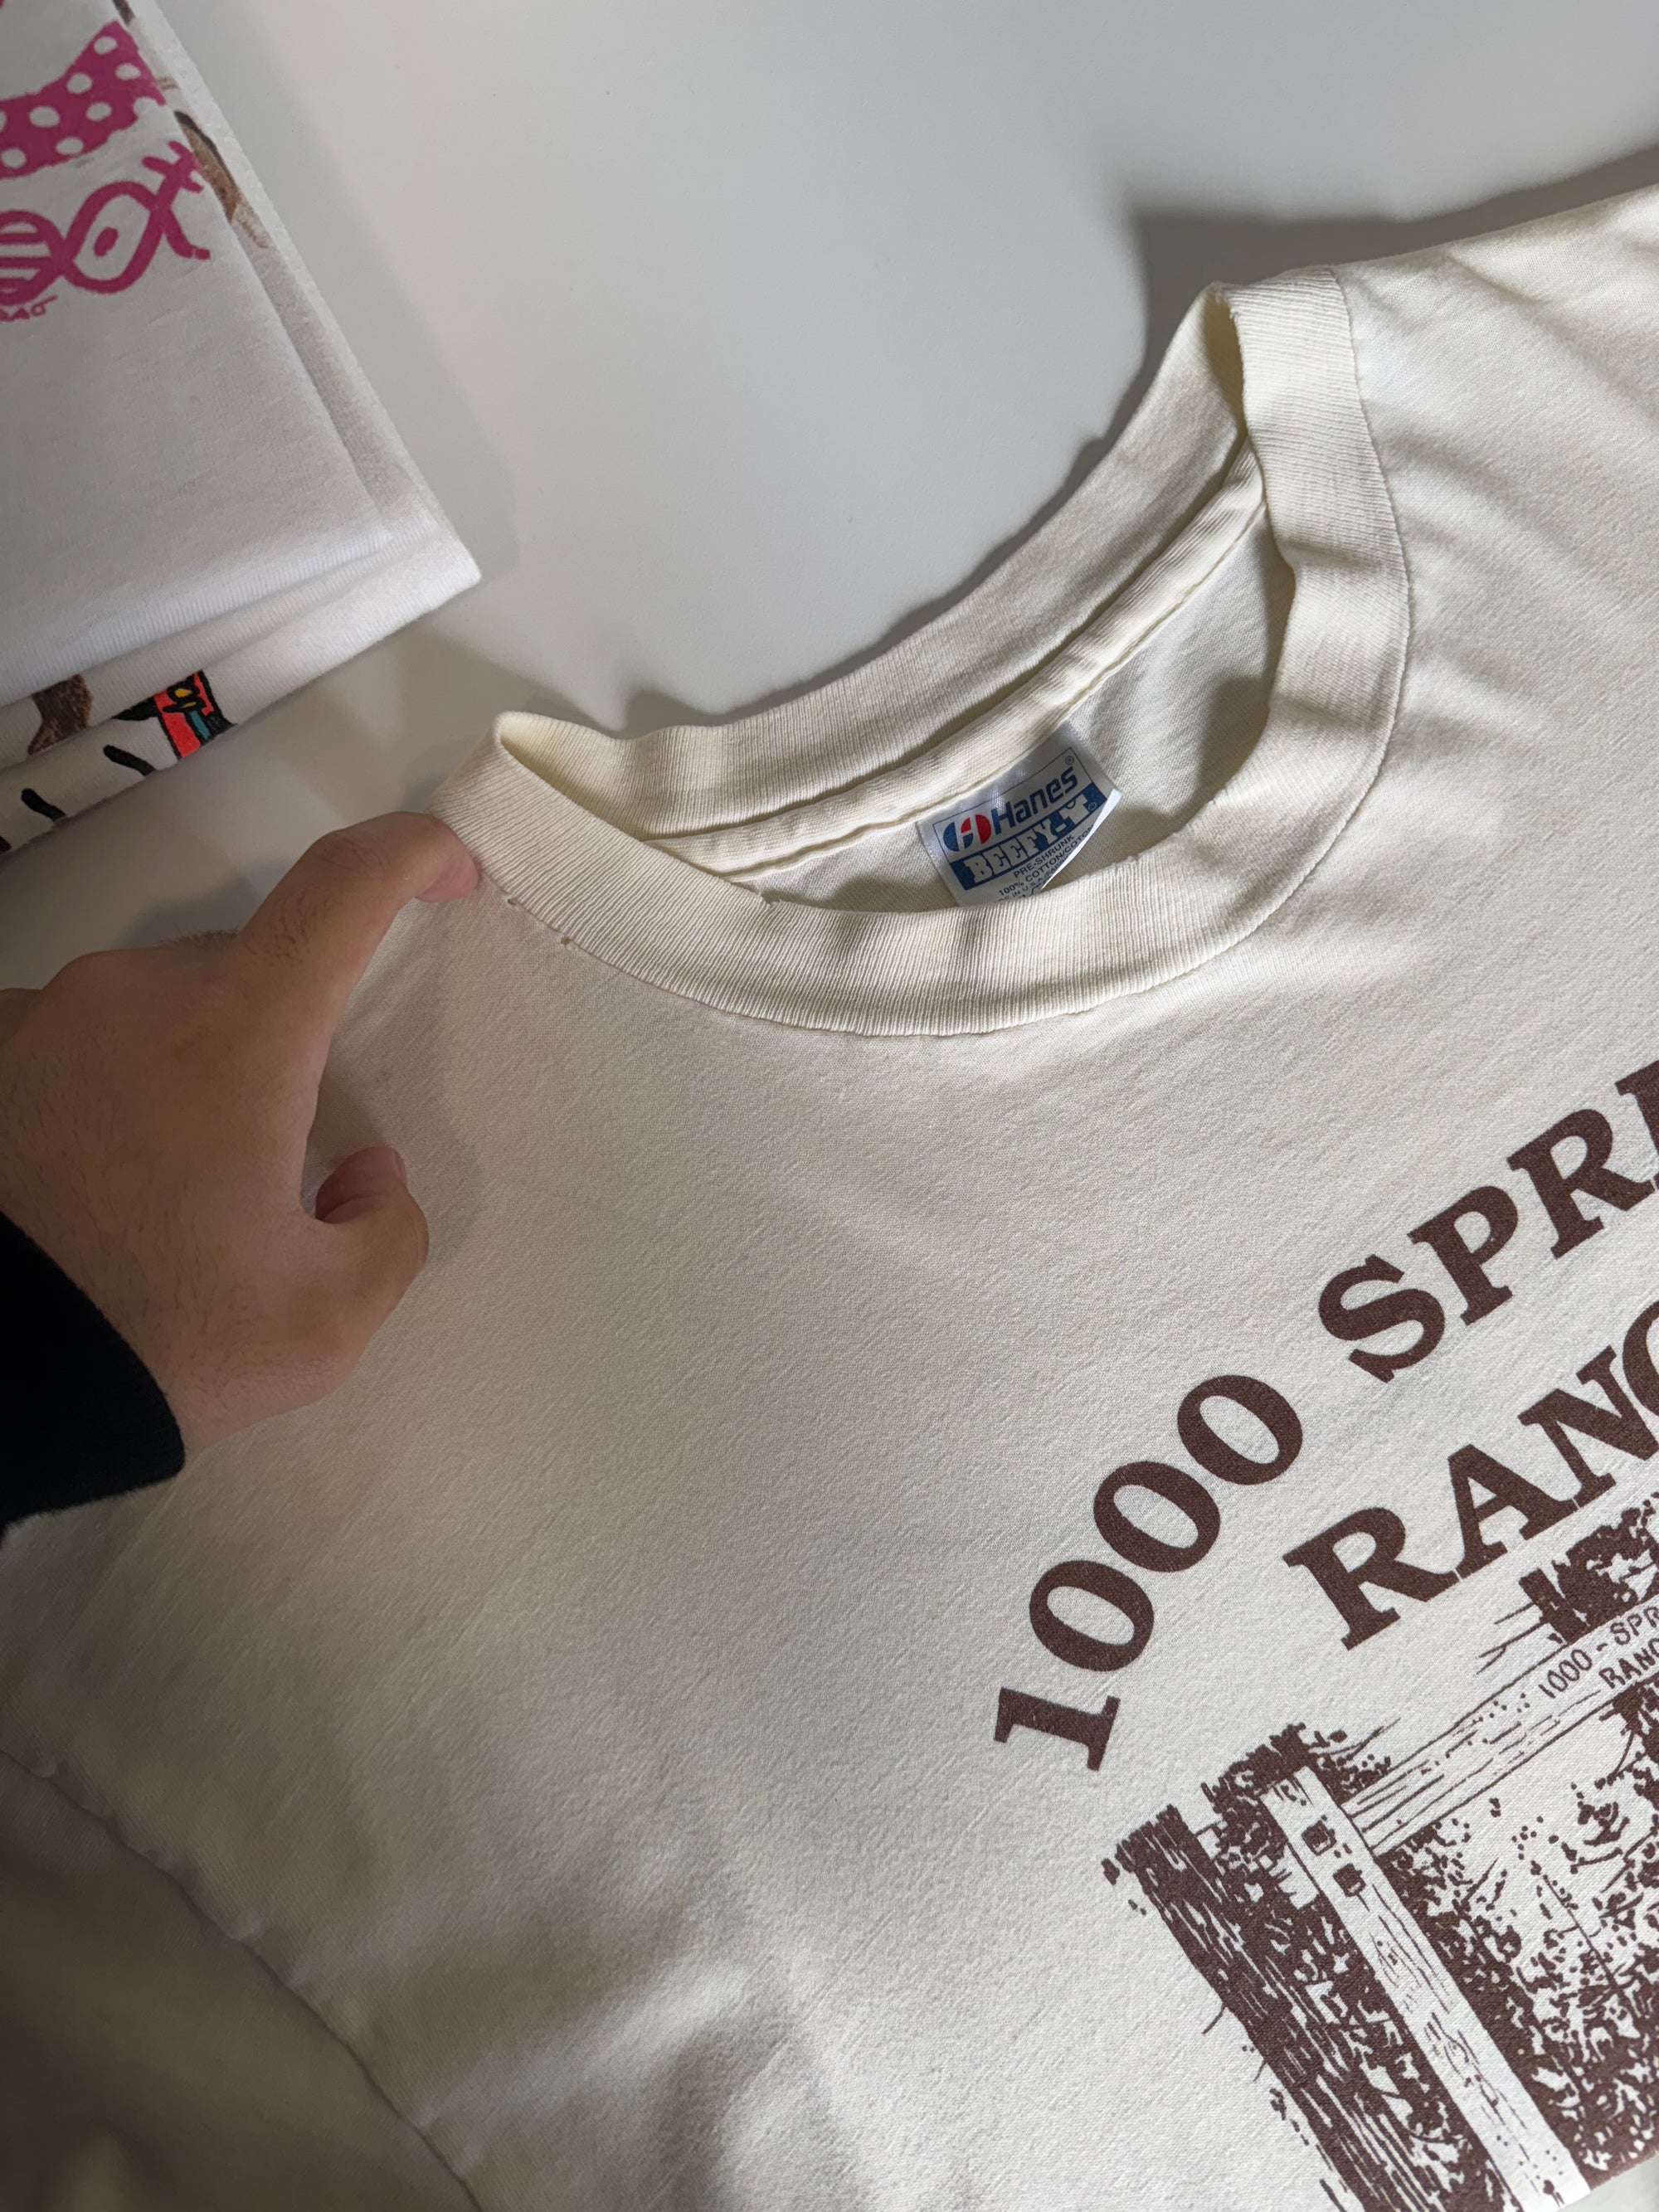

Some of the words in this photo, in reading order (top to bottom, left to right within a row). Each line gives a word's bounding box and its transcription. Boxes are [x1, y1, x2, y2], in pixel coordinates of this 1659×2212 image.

[990, 766, 1078, 835] Hanes
[1013, 834, 1075, 878] PRE-SHRUNK
[998, 881, 1025, 897] 100%
[994, 1373, 1303, 1772] 1000
